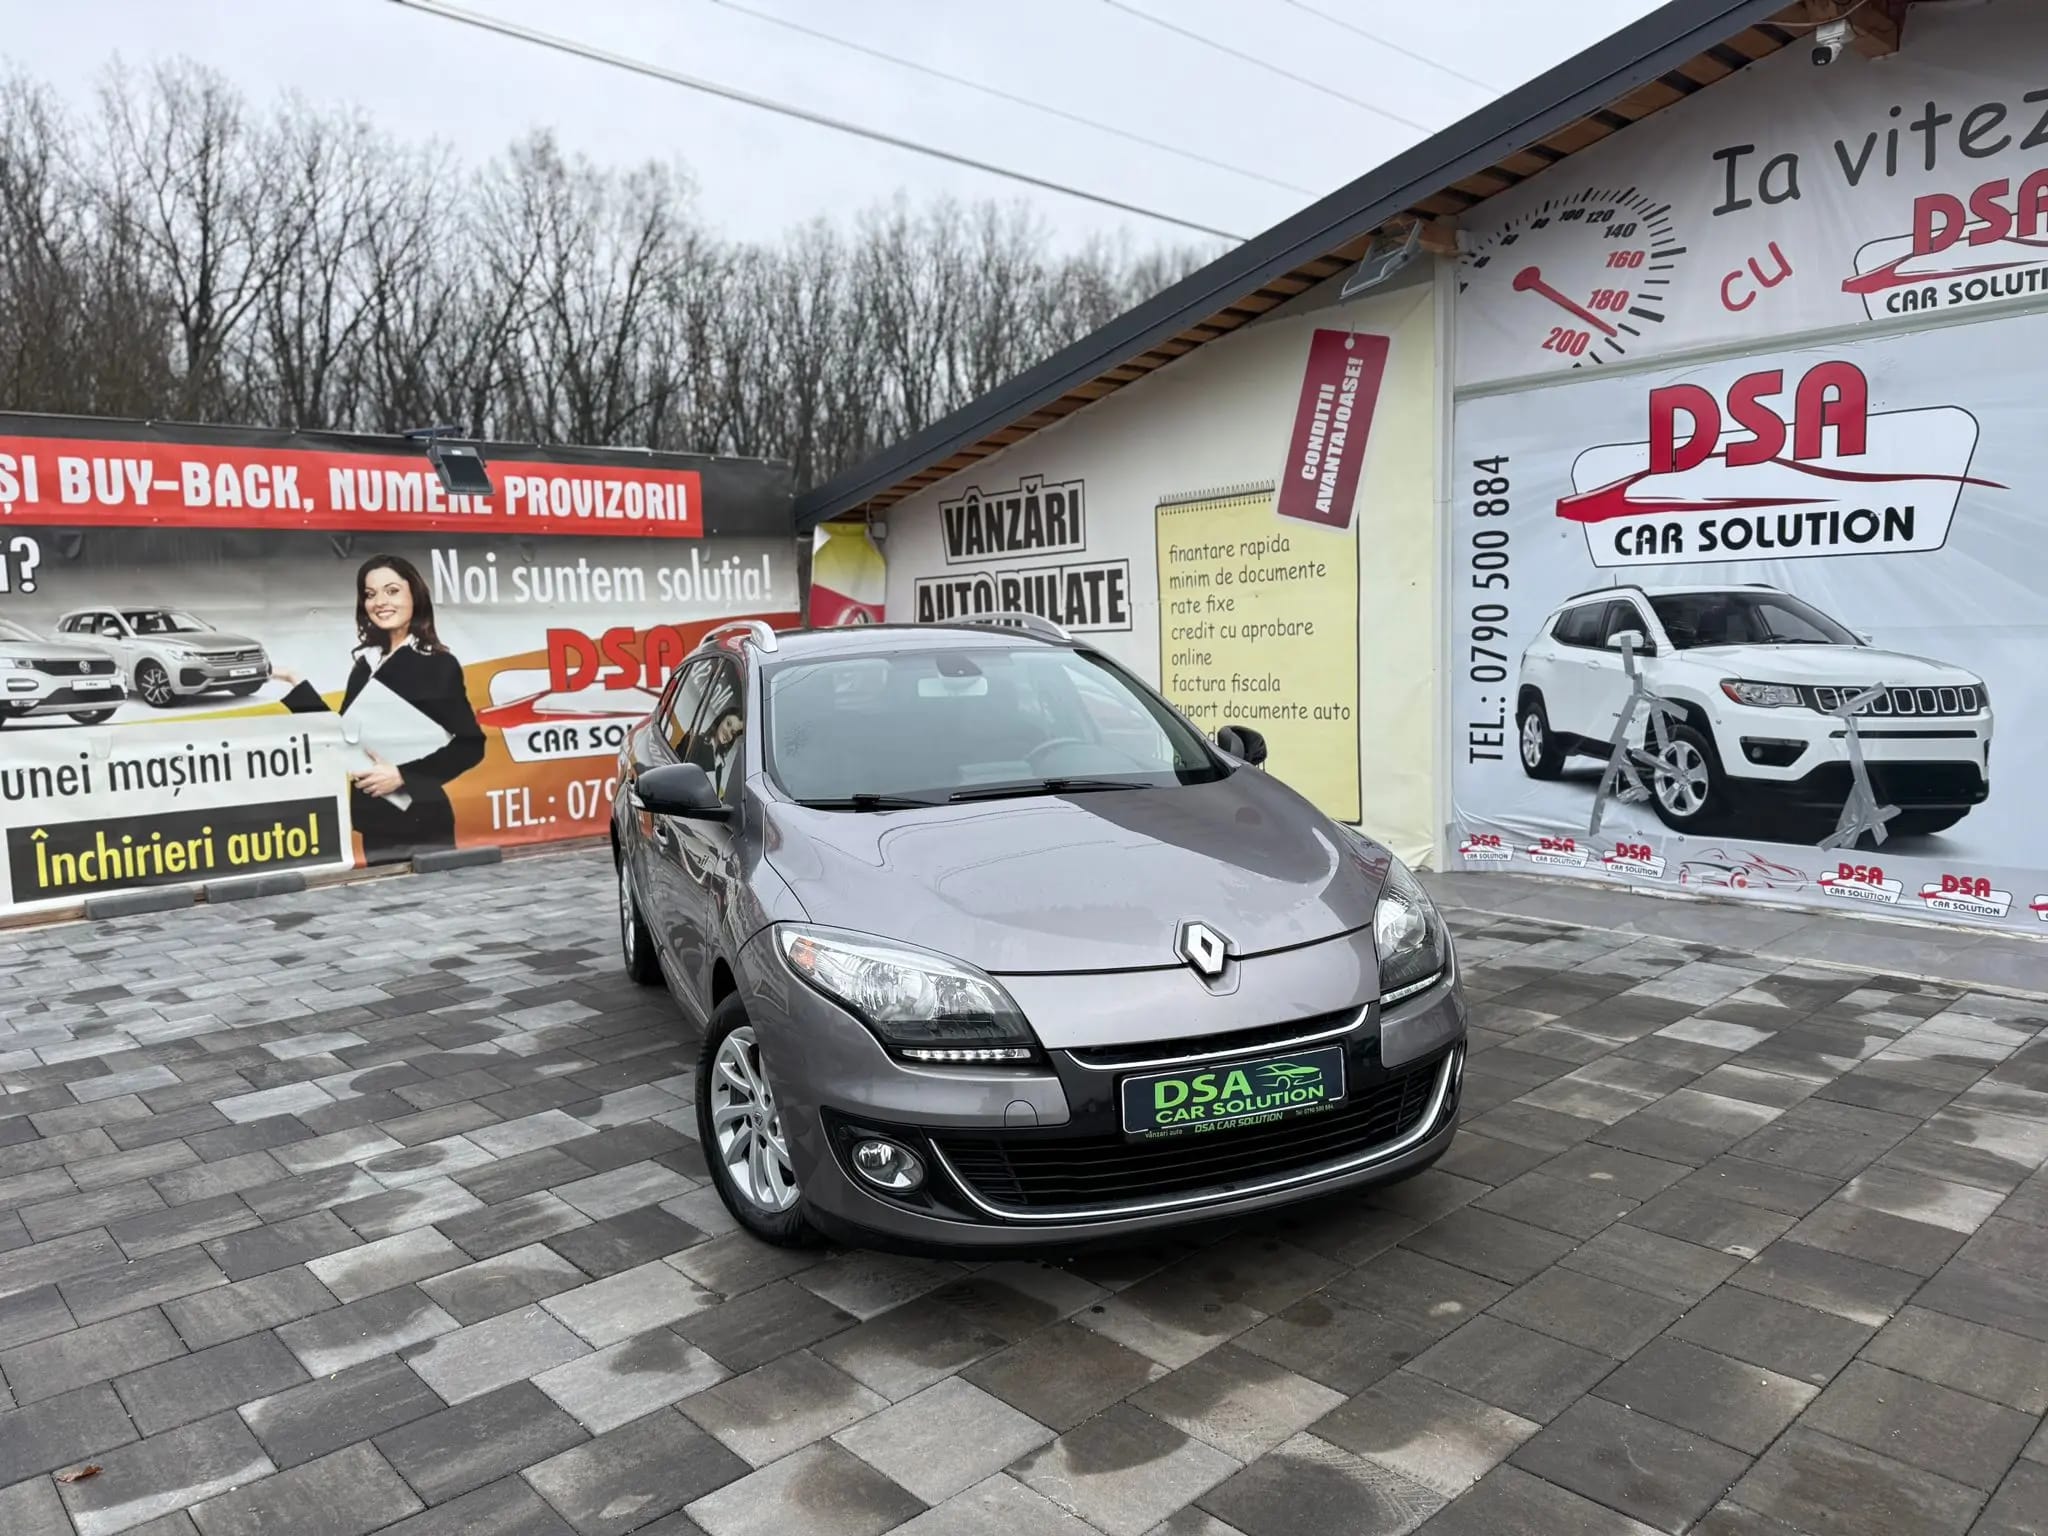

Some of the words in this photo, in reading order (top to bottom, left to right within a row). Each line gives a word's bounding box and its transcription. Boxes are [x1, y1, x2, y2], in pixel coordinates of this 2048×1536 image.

[1713, 144, 1800, 216] Ia
[1585, 209, 1615, 224] 120
[1913, 167, 2048, 257] DSA
[1603, 223, 1637, 239] 140
[1606, 250, 1645, 269] 160
[1720, 241, 1793, 311] cu
[1587, 288, 1630, 312] 180
[1886, 290, 1937, 313] CAR
[1542, 327, 1591, 356] 200
[1301, 383, 1336, 481] CONDITII
[1649, 360, 1868, 475] DSA
[1315, 357, 1364, 514] AVANTAJOASE!
[58, 456, 315, 512] BUY-BACK,
[504, 476, 688, 521] PROVIZORII
[1473, 455, 1510, 517] 884
[944, 484, 1080, 557] VÂNZĂRI
[1614, 522, 1684, 557] CAR
[1699, 505, 1915, 552] SOLUTION
[1169, 542, 1235, 564] finantare
[1240, 533, 1290, 560] rapida
[1472, 531, 1509, 589] 500
[431, 548, 498, 604] Noi
[512, 558, 646, 602] suntem
[1170, 571, 1210, 590] minim
[1215, 568, 1233, 586] de
[1239, 560, 1327, 584] documente
[1171, 599, 1201, 615] rate
[1207, 594, 1235, 614] fixe
[1171, 621, 1215, 640] credit
[1220, 624, 1237, 639] cu
[1241, 618, 1314, 643] aprobare
[1470, 604, 1509, 682] 0790
[547, 625, 685, 692] DSA
[1171, 648, 1213, 666] online
[1172, 674, 1226, 693] factura
[1231, 673, 1281, 693] fiscala
[1174, 701, 1218, 719] uport
[1223, 700, 1309, 720] documente
[1313, 702, 1351, 720] auto
[528, 727, 579, 754] CAR
[589, 724, 632, 748] SO
[2, 752, 91, 802] unei
[108, 742, 232, 797] mașini
[248, 733, 313, 779] noi!
[31, 826, 215, 889] Închirieri
[228, 813, 320, 866] auto!
[1540, 838, 1576, 853] DSA
[1616, 842, 1653, 861] DSA
[1625, 866, 1658, 876] SOLUTION
[1838, 863, 1883, 885] DSA
[1941, 874, 1991, 897] DSA
[1829, 887, 1846, 896] CAR
[1848, 888, 1892, 902] SOLUTION
[1933, 900, 1950, 909] CAR
[1953, 902, 2001, 915] SOLUTION
[1154, 1070, 1253, 1110] DSA
[1155, 1105, 1206, 1124] CAR
[1212, 1085, 1324, 1115] SOLUTION
[1195, 1123, 1215, 1134] DSA
[1216, 1119, 1236, 1131] CAR
[1237, 1112, 1284, 1128] SOLUTION
